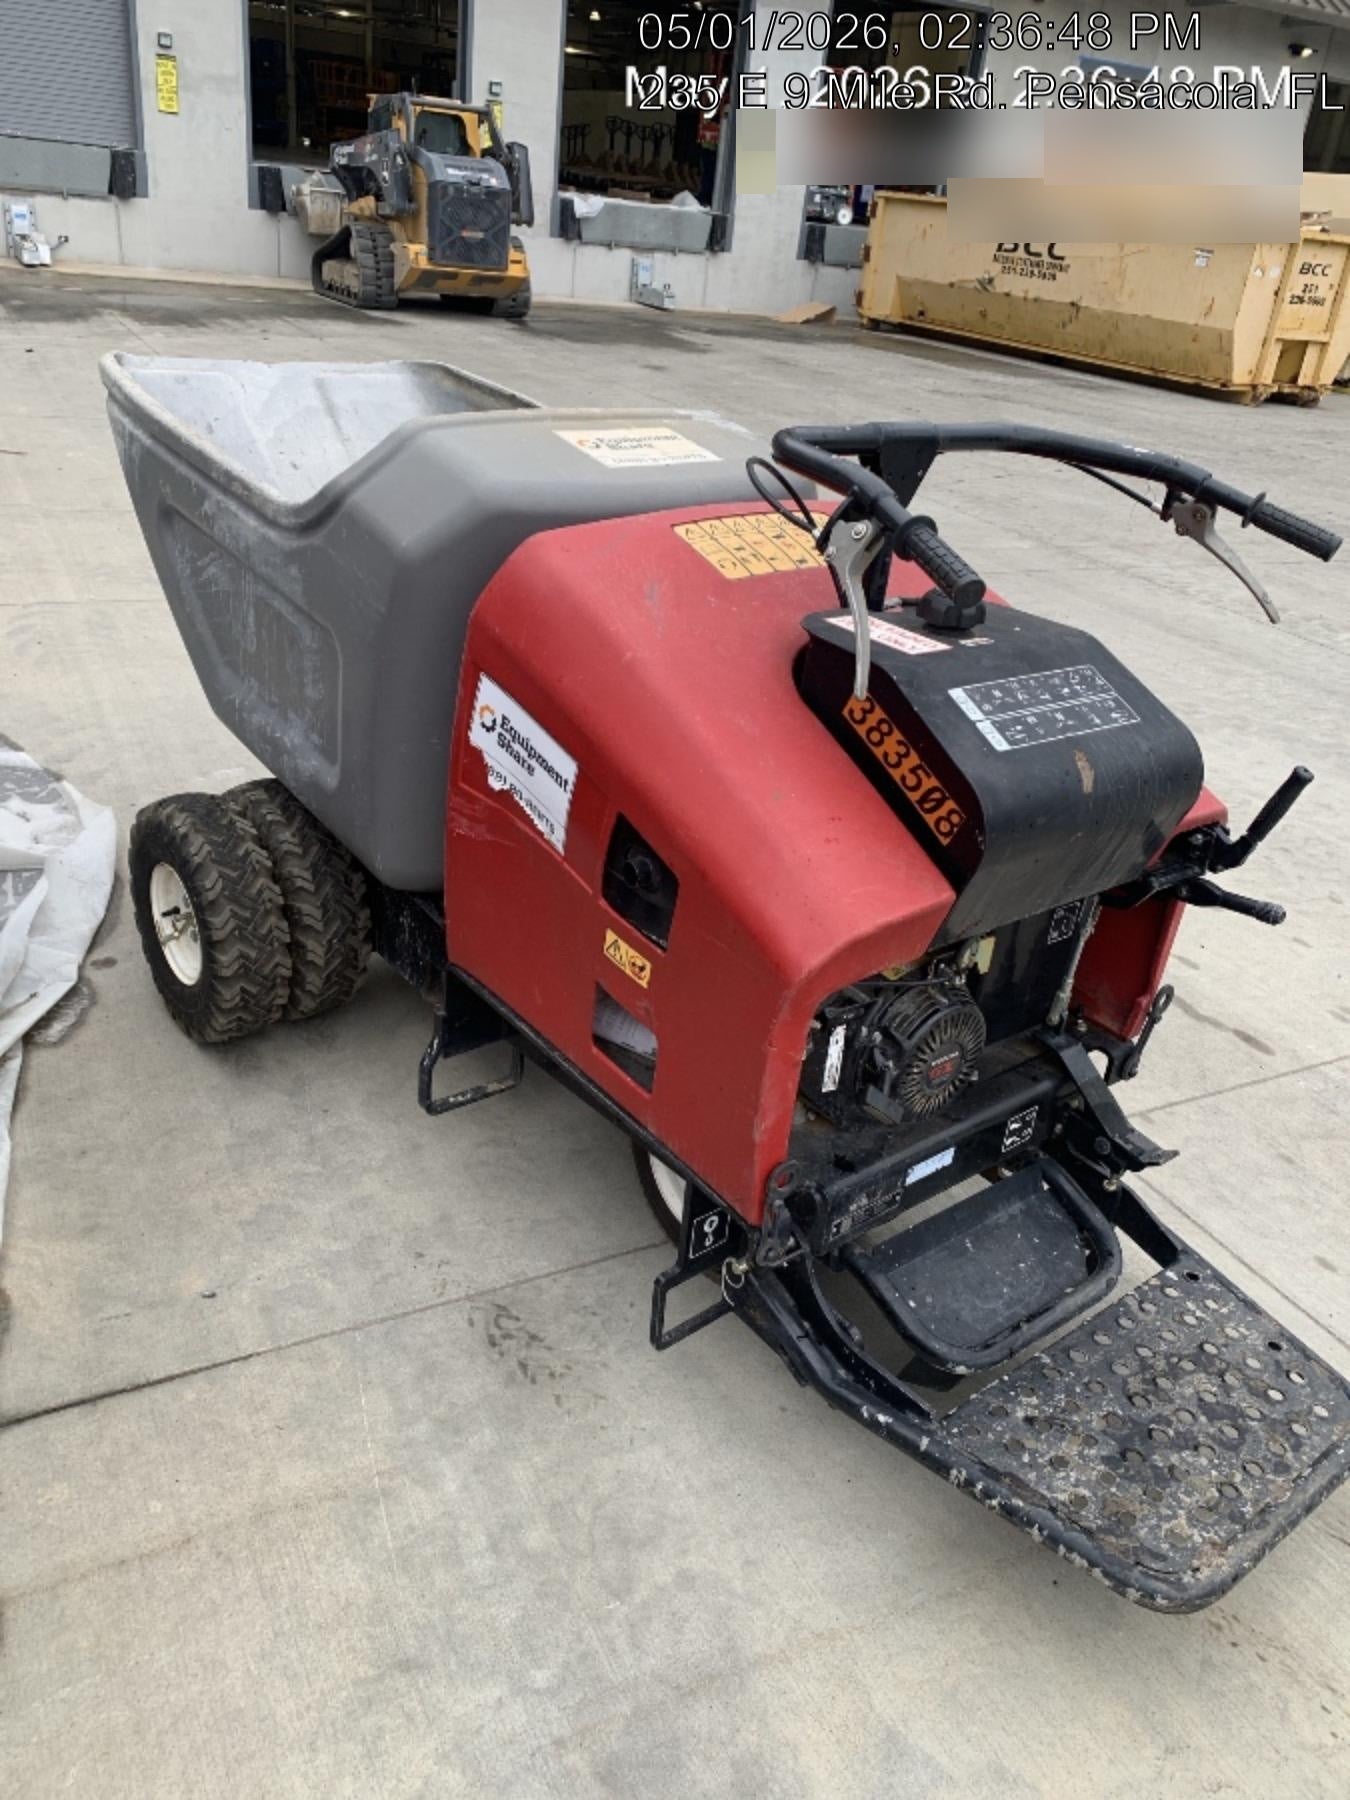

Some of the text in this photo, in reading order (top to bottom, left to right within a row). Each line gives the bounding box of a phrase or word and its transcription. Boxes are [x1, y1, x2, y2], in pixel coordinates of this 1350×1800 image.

[1299, 261, 1333, 277] BCC
[497, 732, 535, 777] Share
[500, 713, 570, 793] Equipment
[848, 695, 963, 838] 383508
